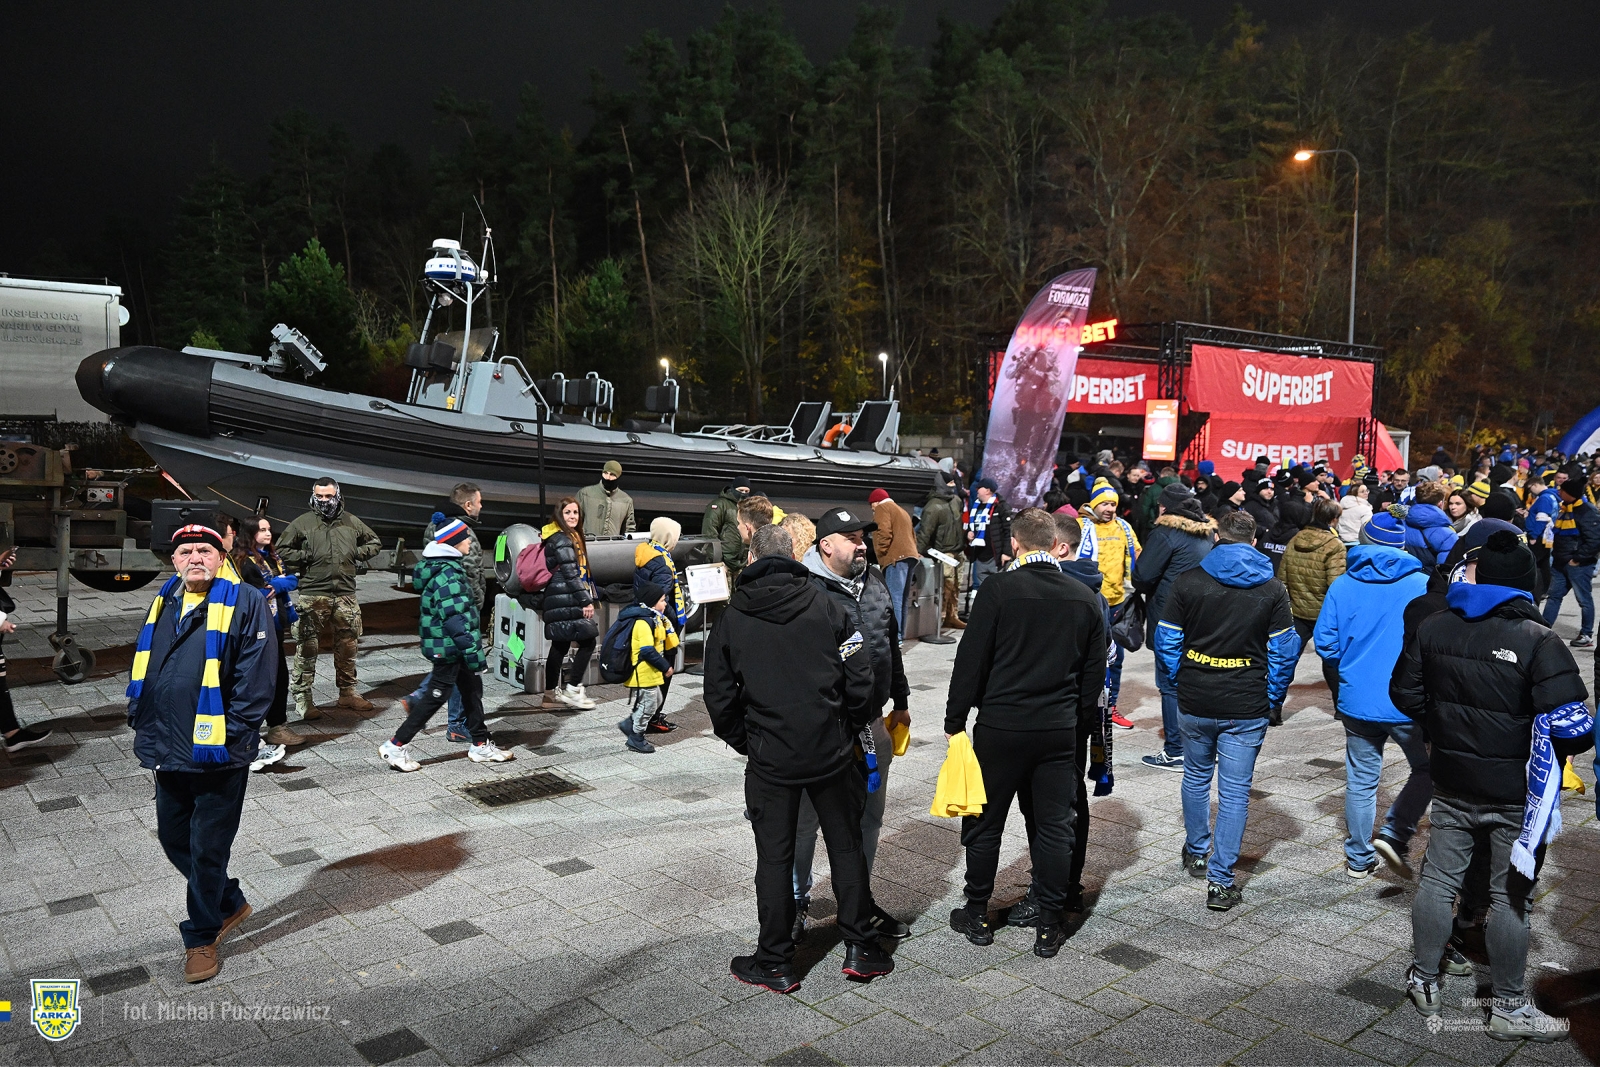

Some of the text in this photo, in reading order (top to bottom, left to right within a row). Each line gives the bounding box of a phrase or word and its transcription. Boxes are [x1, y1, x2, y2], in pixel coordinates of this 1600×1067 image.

[1047, 290, 1090, 307] FORMOZA
[1, 308, 81, 321] INSPEKTORAT
[46, 324, 82, 334] GDYNI
[1068, 373, 1147, 405] UPERBET
[1242, 364, 1334, 405] SUPERBET
[1221, 439, 1344, 464] SUPERBET
[1186, 649, 1252, 668] SUPERBET
